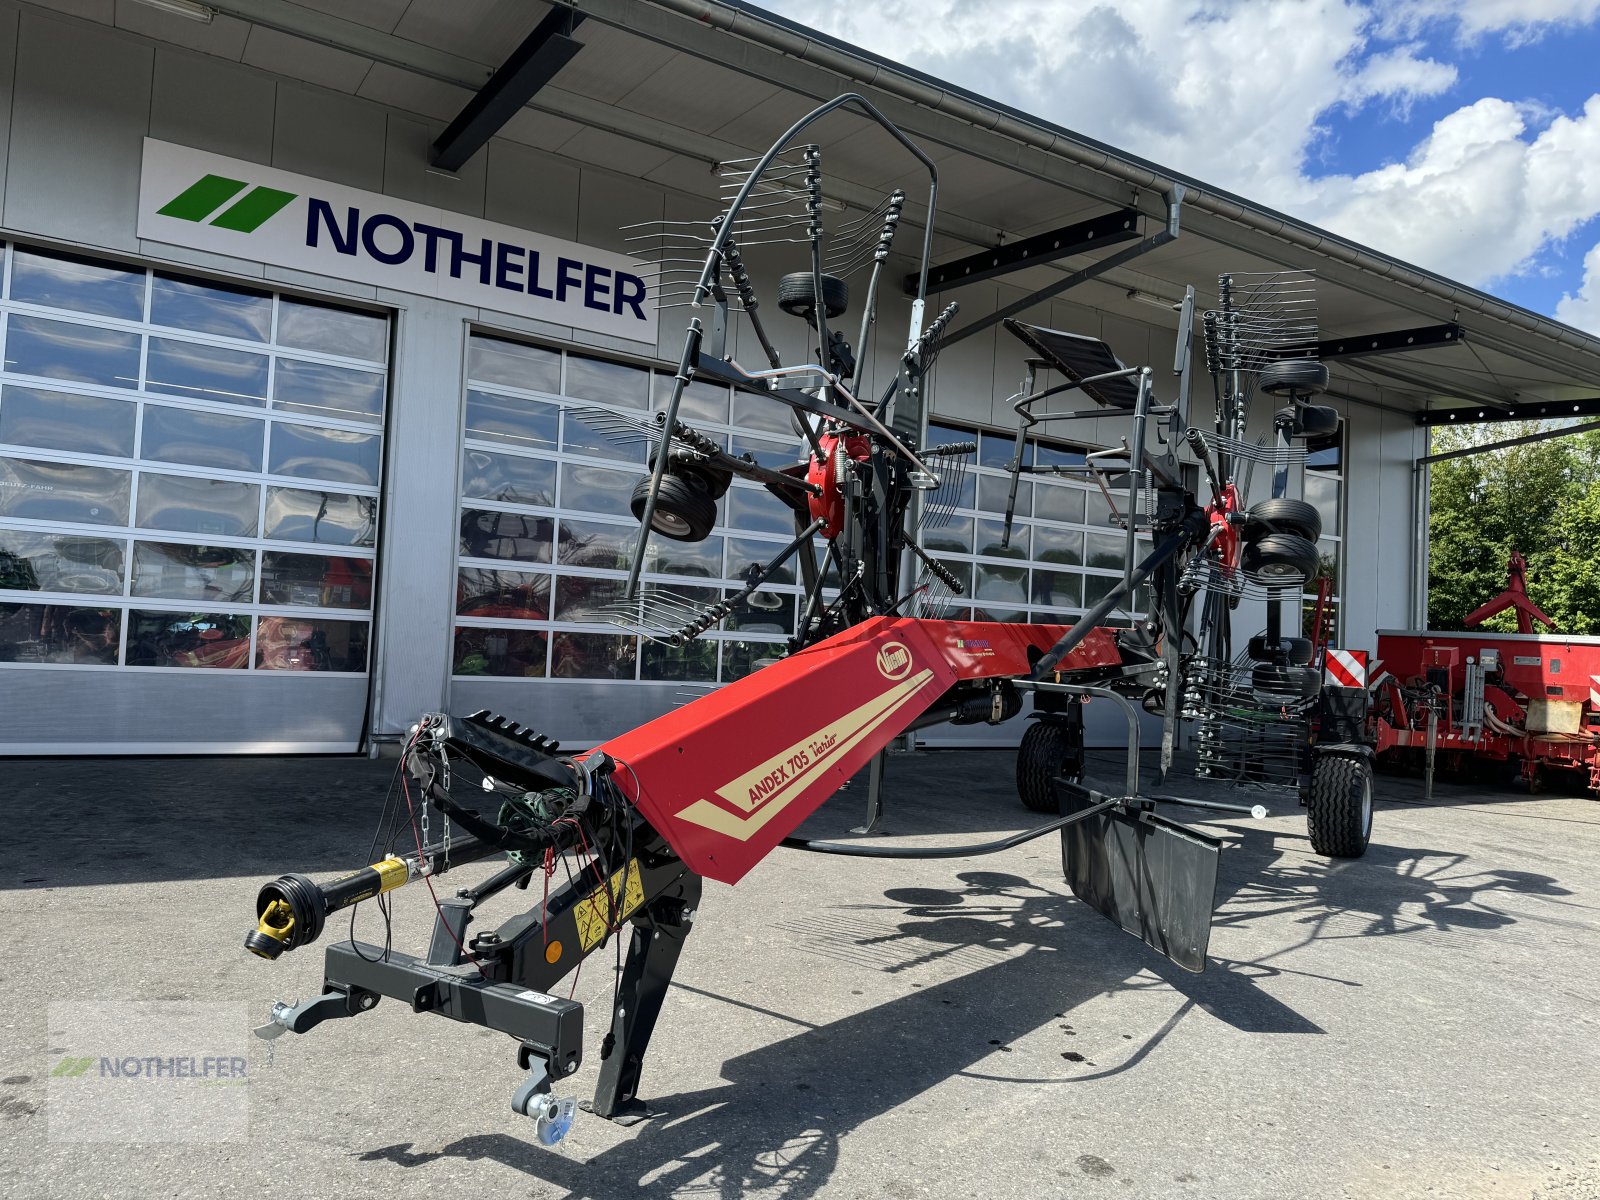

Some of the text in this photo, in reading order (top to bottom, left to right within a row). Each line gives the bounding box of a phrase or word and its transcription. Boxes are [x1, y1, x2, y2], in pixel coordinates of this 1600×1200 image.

[305, 197, 647, 320] NOTHELFER
[878, 646, 908, 674] Vicon
[748, 733, 837, 805] ANDEX 705 Vario
